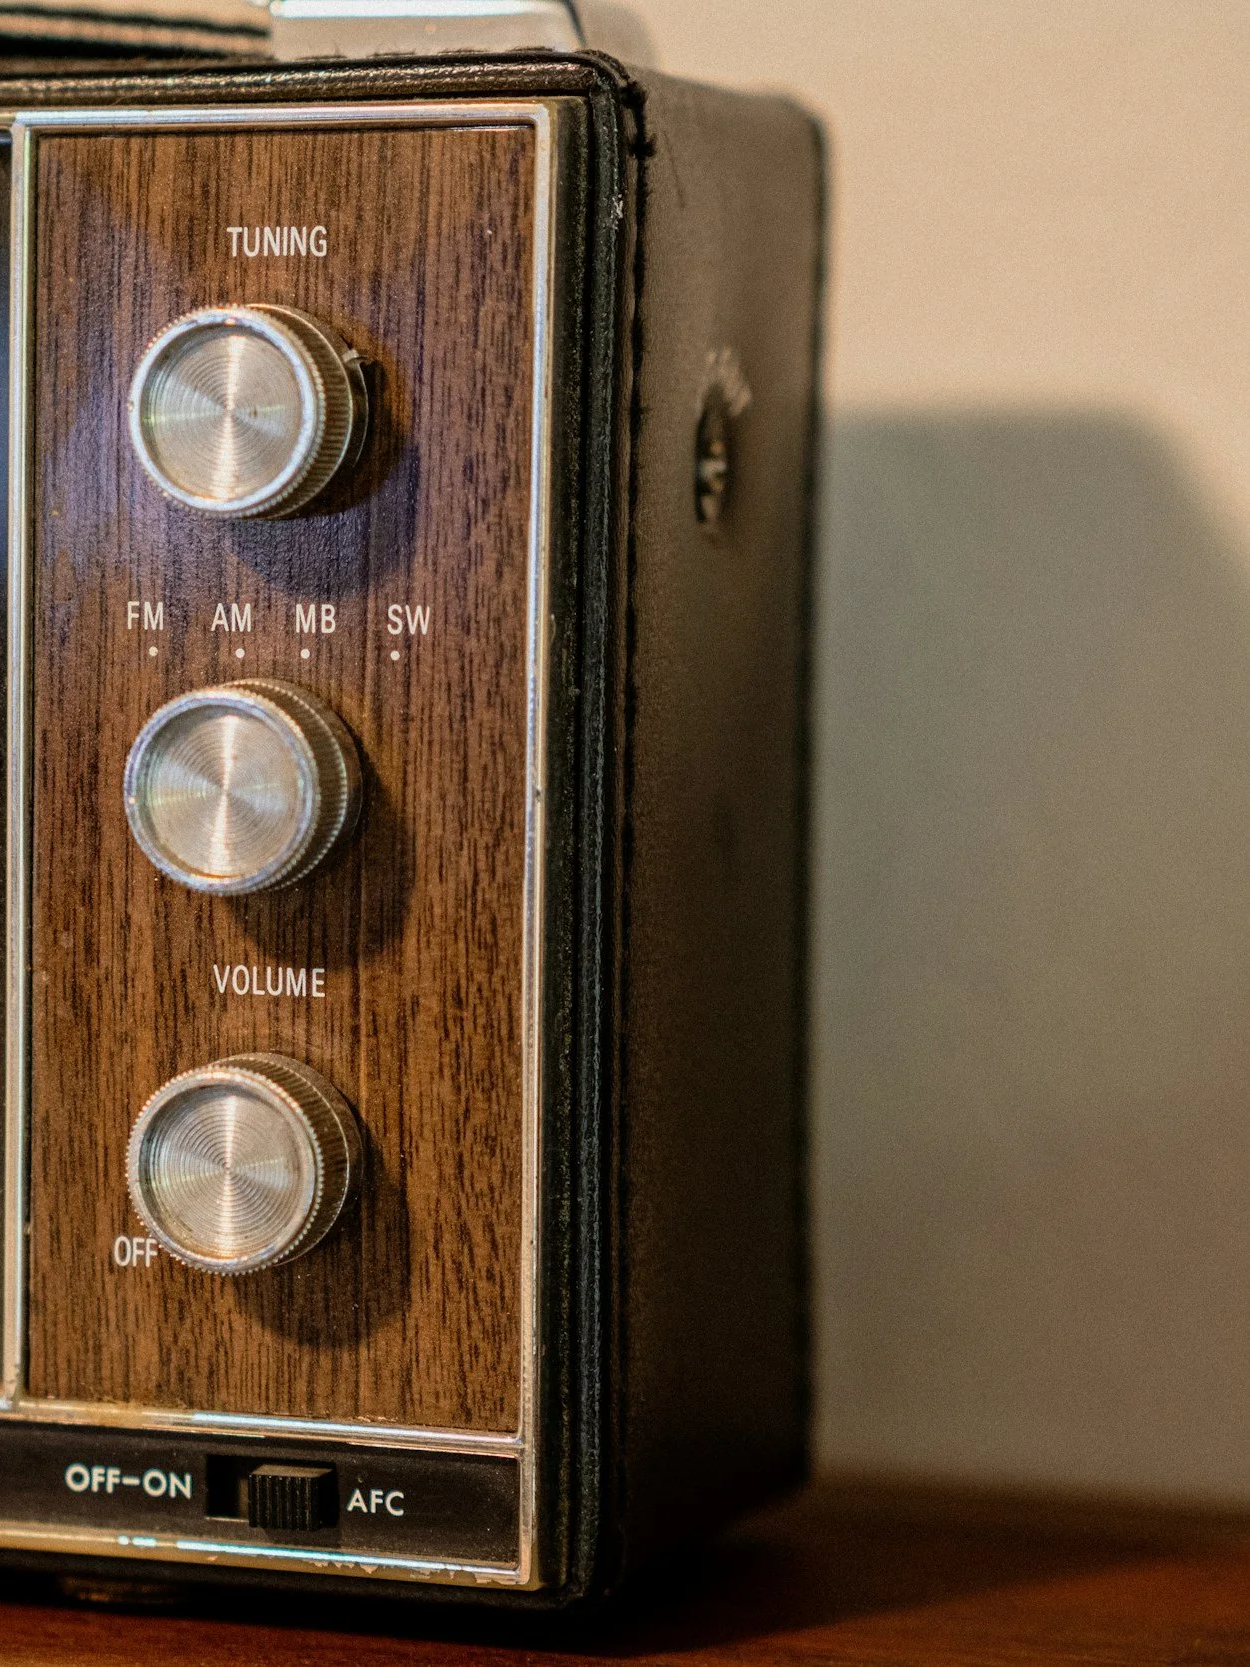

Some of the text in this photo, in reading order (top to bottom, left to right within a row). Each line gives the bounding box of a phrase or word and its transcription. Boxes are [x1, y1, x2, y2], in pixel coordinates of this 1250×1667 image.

[227, 226, 327, 257] TUNING
[128, 602, 431, 635] FM AM MB SW
[213, 964, 325, 998] VOLUME
[114, 1236, 158, 1268] OFF
[65, 1464, 192, 1498] OFF-ON
[348, 1488, 405, 1516] AFC
